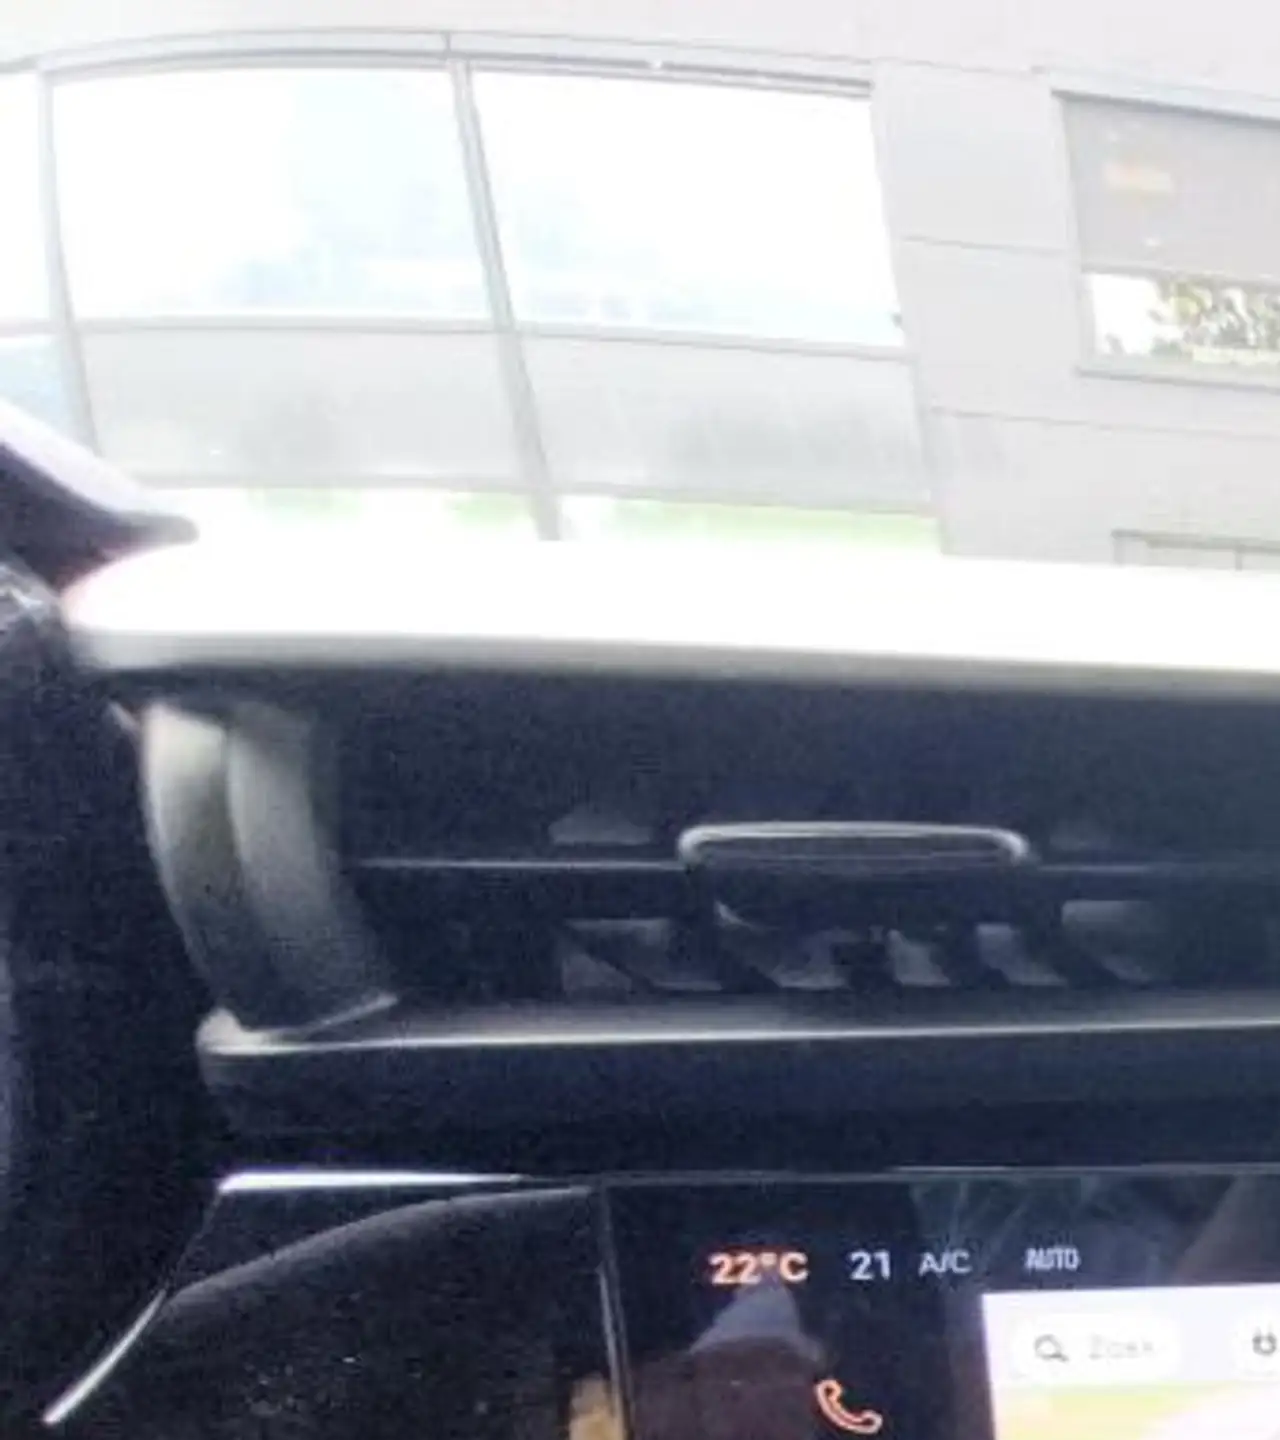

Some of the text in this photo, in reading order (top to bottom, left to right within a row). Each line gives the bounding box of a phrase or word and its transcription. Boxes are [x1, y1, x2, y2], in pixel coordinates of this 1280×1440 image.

[708, 1245, 1080, 1285] 22°C 21 A/C AUTO
